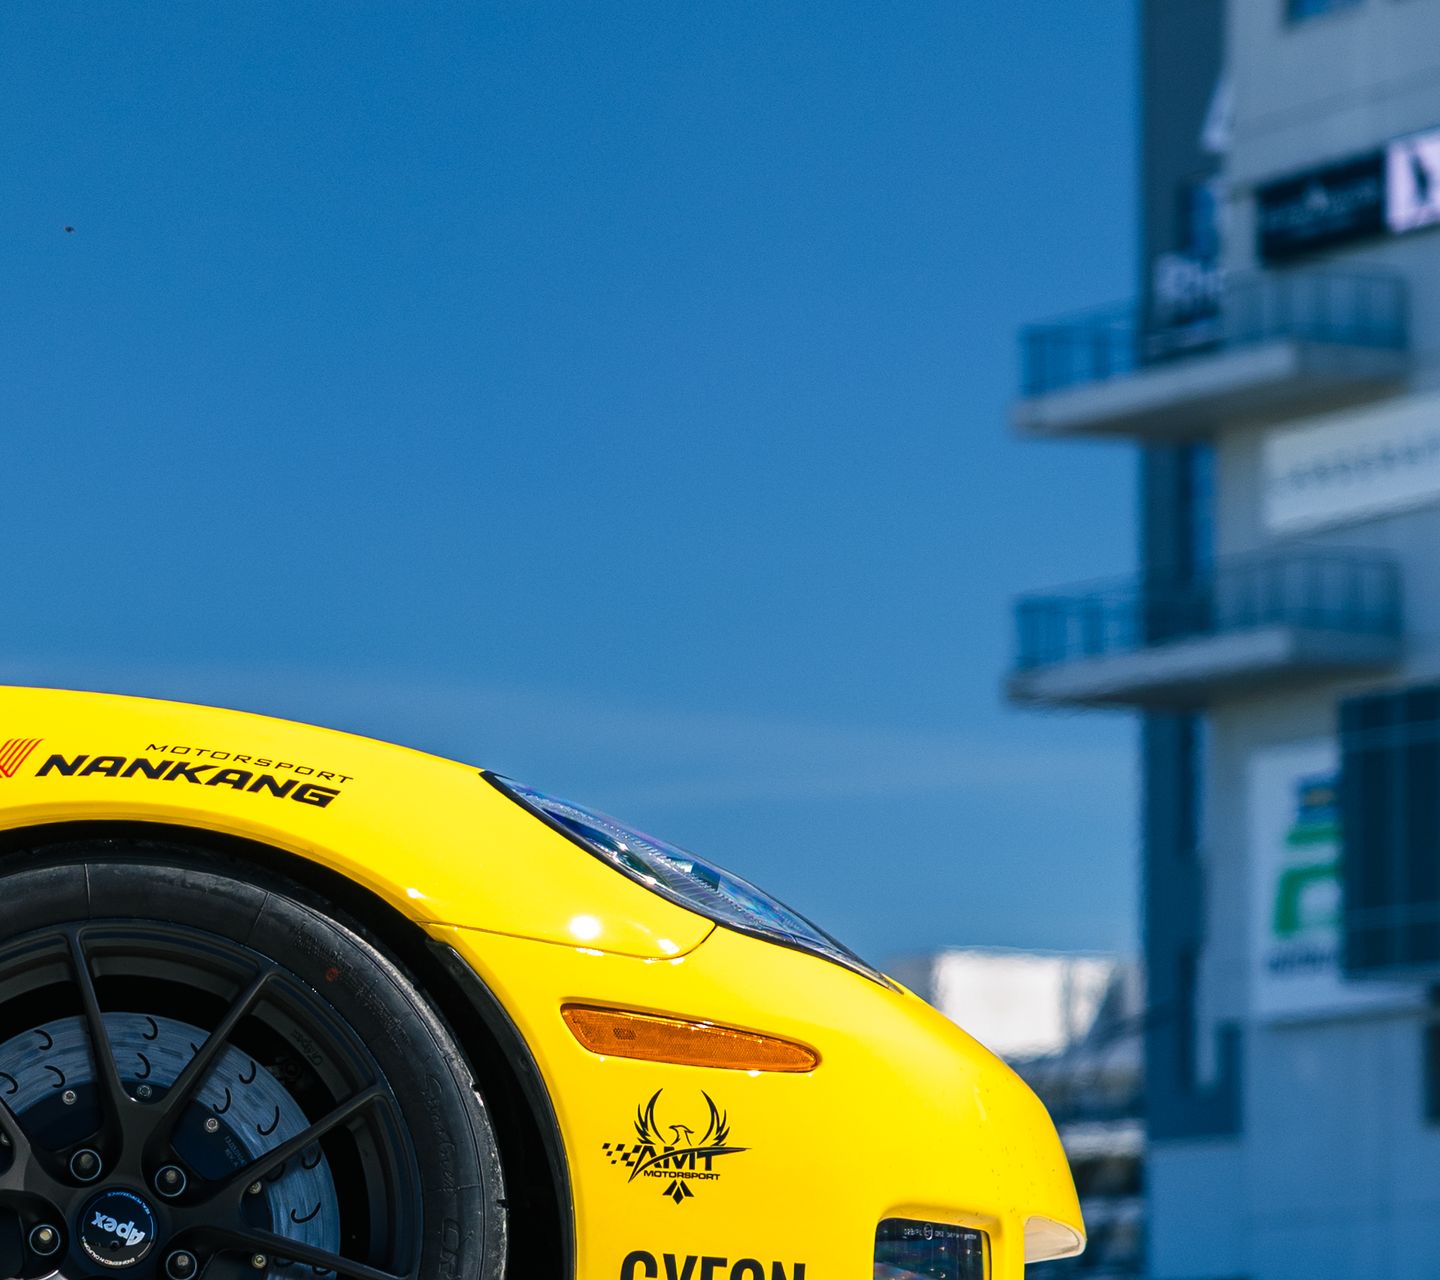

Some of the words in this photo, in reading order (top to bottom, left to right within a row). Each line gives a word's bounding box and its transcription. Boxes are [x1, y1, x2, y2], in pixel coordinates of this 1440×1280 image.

[35, 754, 340, 808] NANKANG
[145, 744, 353, 783] MOTORSPORT
[628, 1146, 720, 1177] AMT
[644, 1170, 720, 1180] MOTORSPORT
[91, 1211, 145, 1246] Apex
